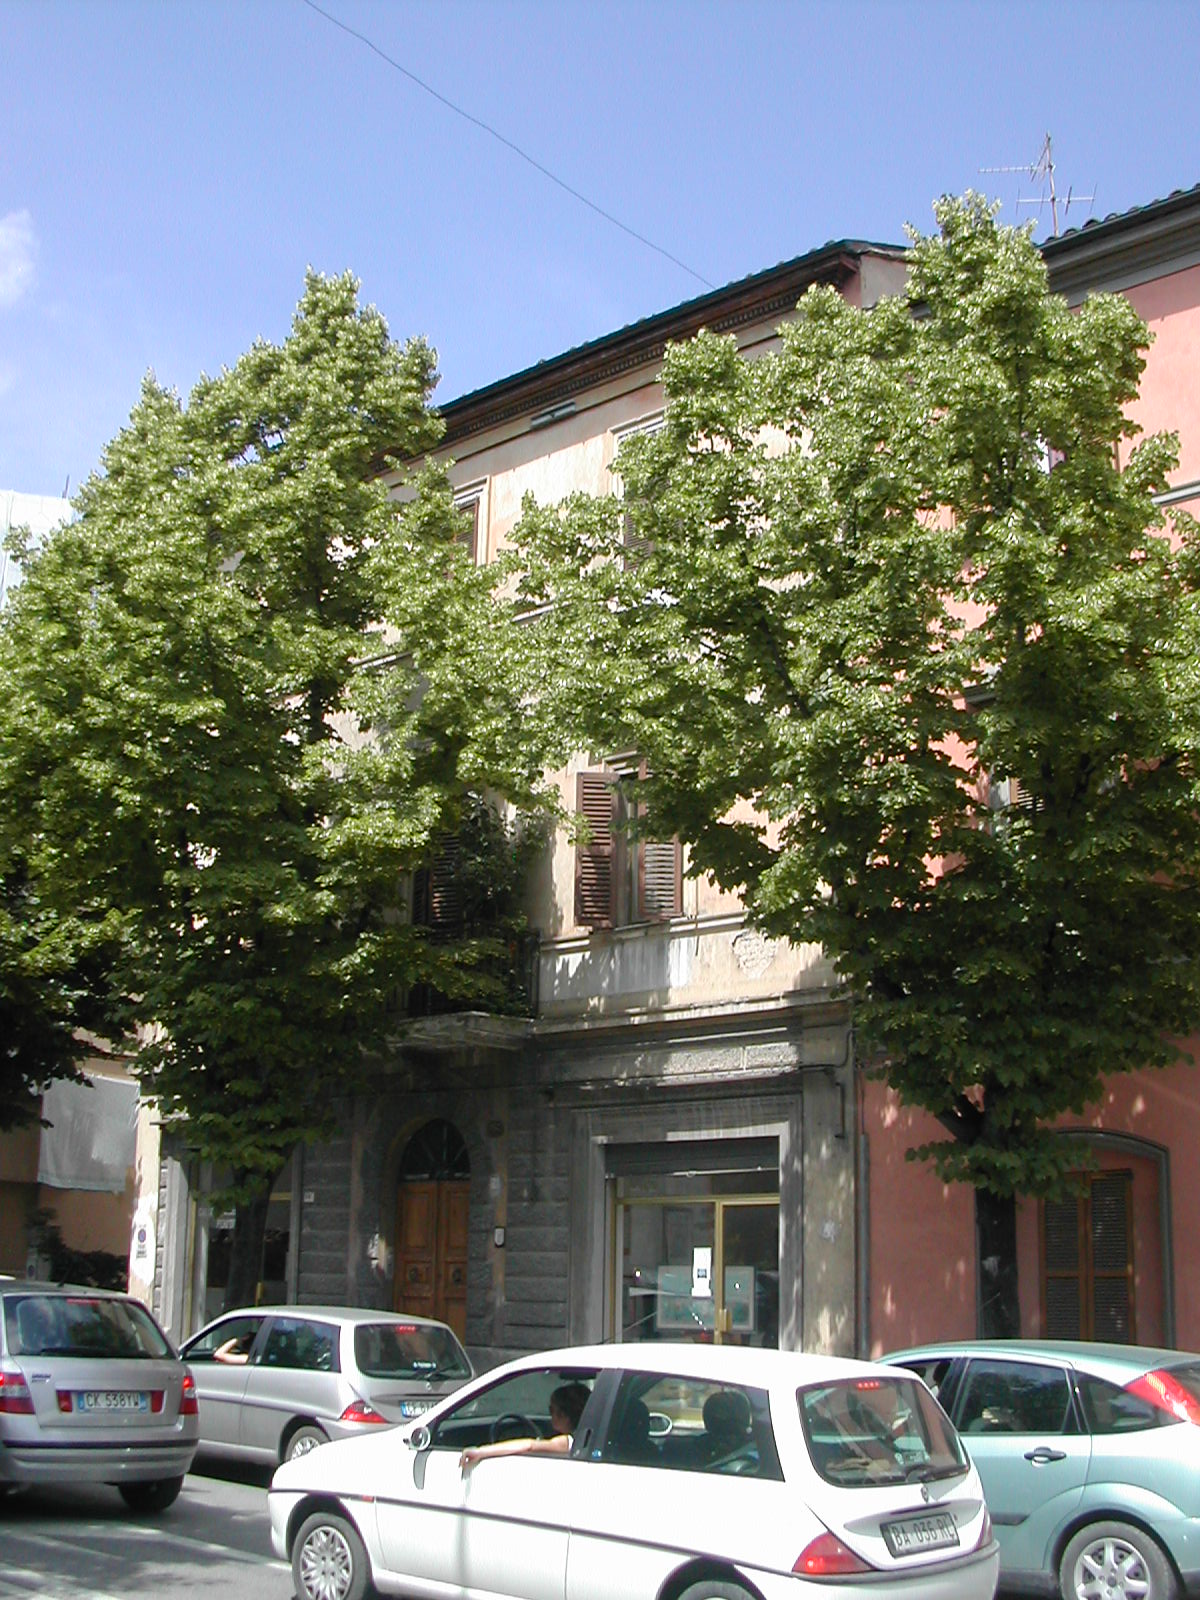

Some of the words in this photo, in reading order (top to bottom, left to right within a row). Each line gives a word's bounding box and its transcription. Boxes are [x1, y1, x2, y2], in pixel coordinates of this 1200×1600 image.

[86, 1392, 100, 1407] CK
[891, 1525, 911, 1545] BA
[913, 1520, 938, 1543] 036
